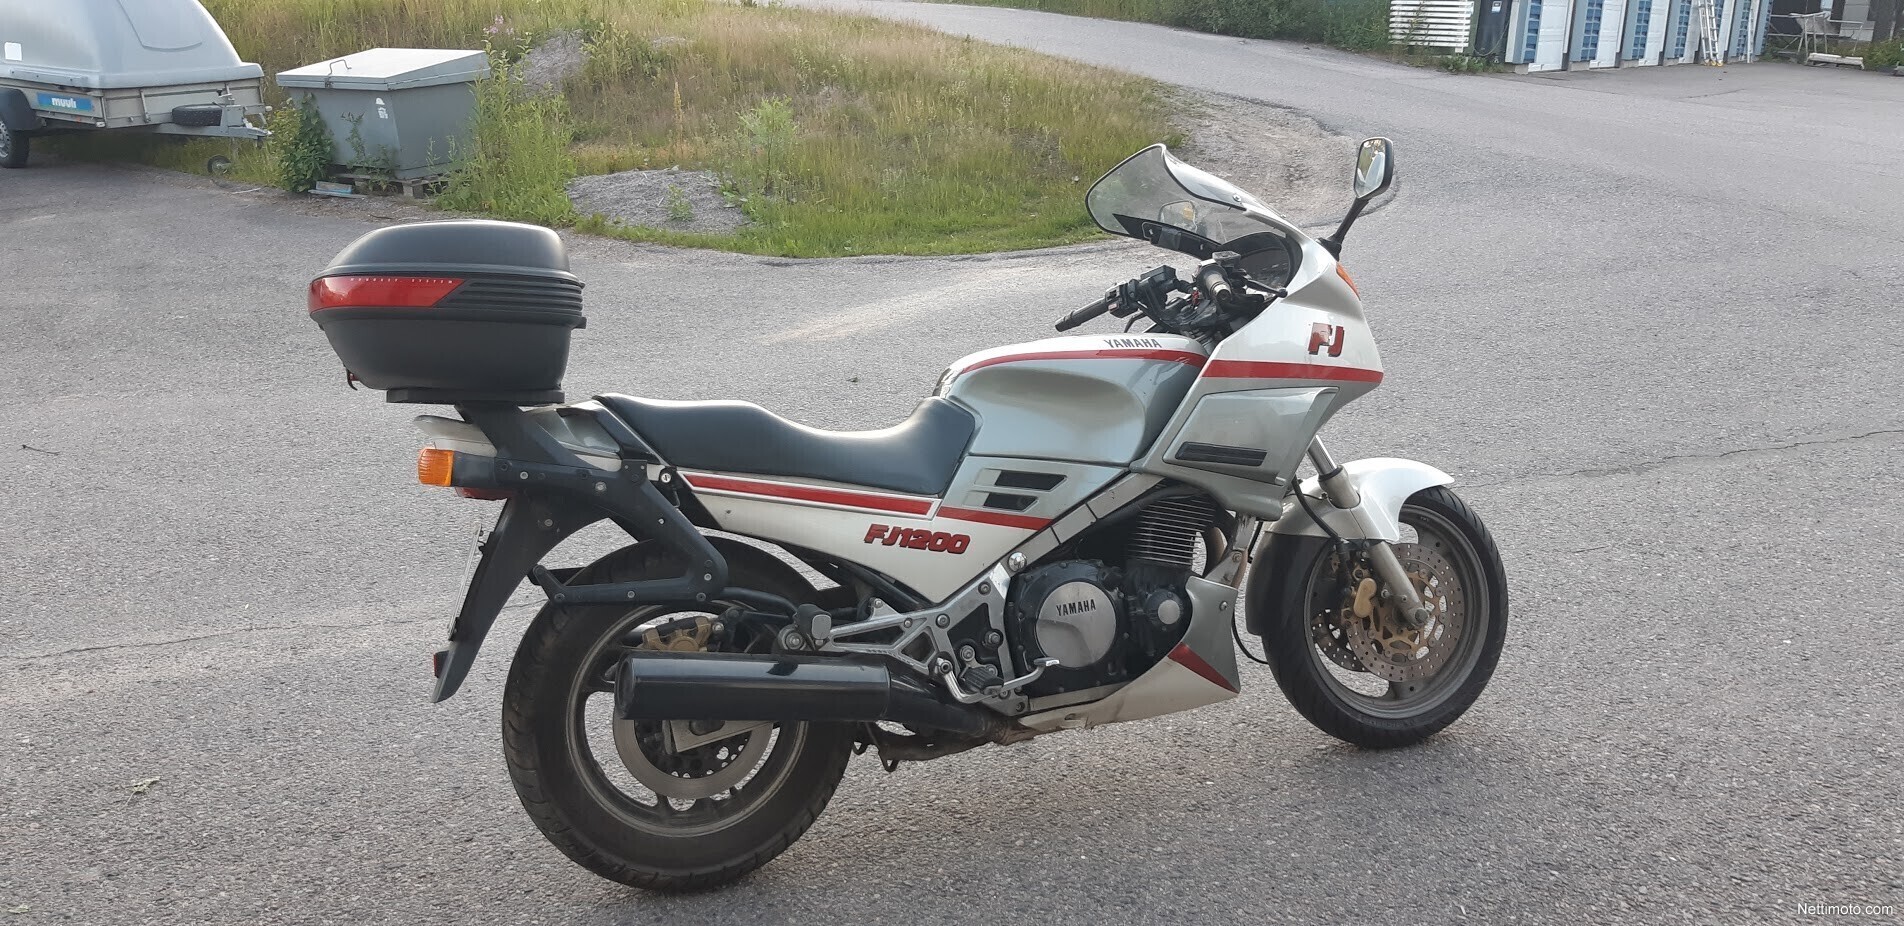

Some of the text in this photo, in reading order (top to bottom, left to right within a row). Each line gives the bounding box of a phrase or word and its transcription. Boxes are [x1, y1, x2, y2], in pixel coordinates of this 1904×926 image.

[1103, 338, 1162, 348] YAMAHA
[1308, 322, 1345, 357] FJ
[864, 523, 971, 554] FJ1200
[1056, 599, 1096, 616] YAMAHA
